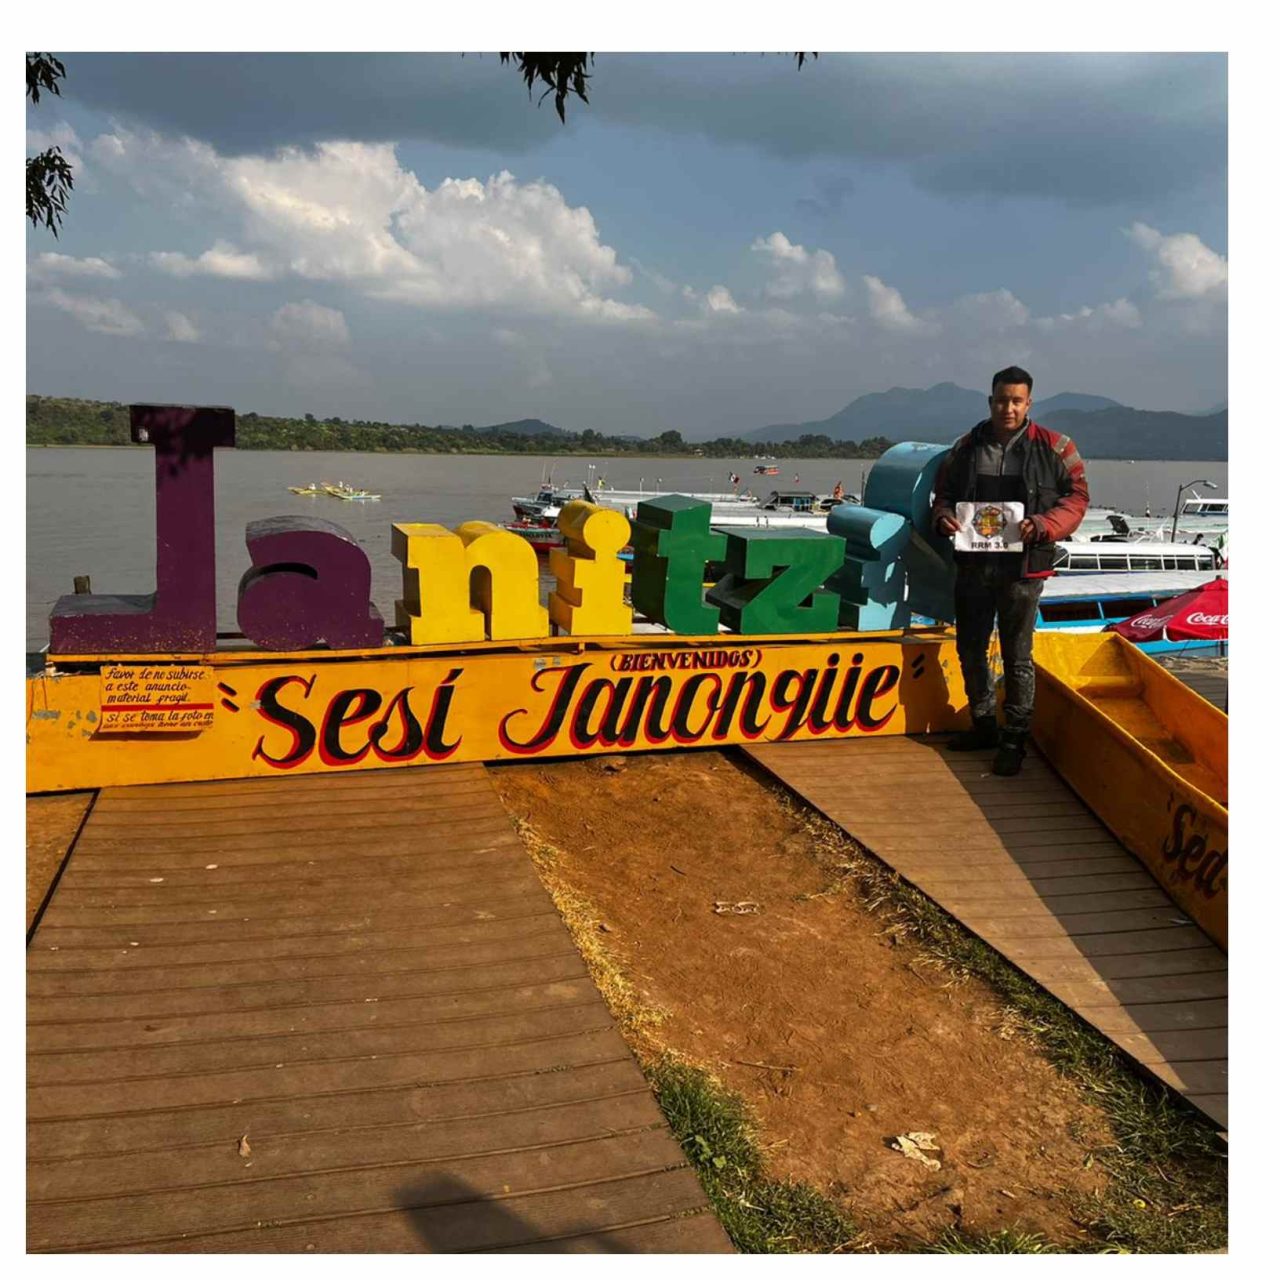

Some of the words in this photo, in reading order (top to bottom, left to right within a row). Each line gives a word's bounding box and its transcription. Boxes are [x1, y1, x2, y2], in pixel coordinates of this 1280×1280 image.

[166, 667, 205, 680] subirse
[105, 682, 113, 692] a
[117, 681, 138, 692] este
[107, 692, 151, 703] material
[122, 713, 137, 722] se
[140, 709, 165, 721] toma
[168, 710, 179, 721] la
[180, 710, 202, 721] foto
